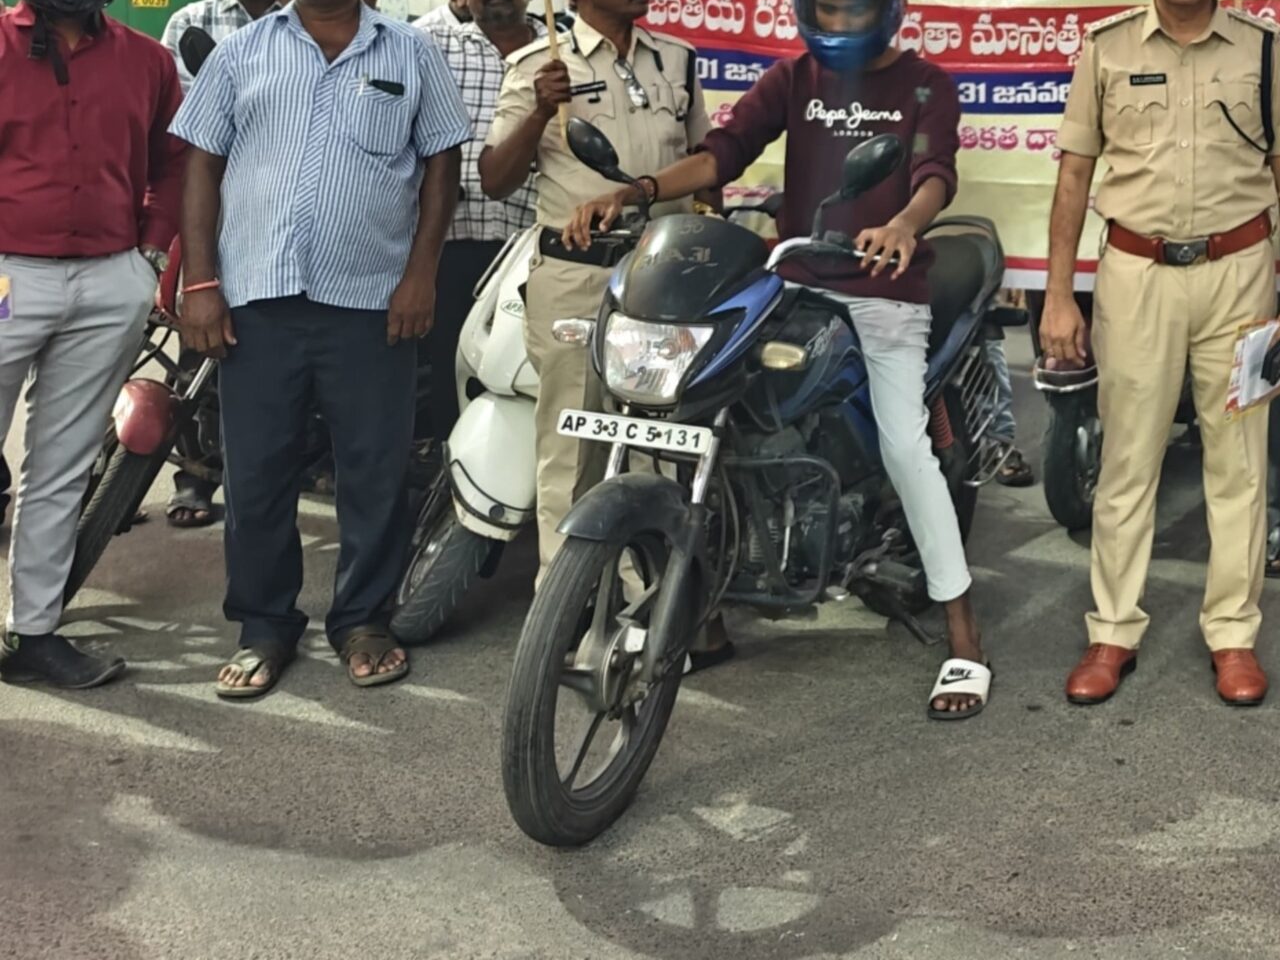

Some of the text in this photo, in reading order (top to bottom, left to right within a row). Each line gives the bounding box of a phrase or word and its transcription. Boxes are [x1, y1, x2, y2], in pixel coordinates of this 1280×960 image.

[957, 82, 987, 104] 31
[806, 98, 904, 129] Pepe Jeans
[561, 414, 587, 433] AP
[625, 422, 639, 440] C
